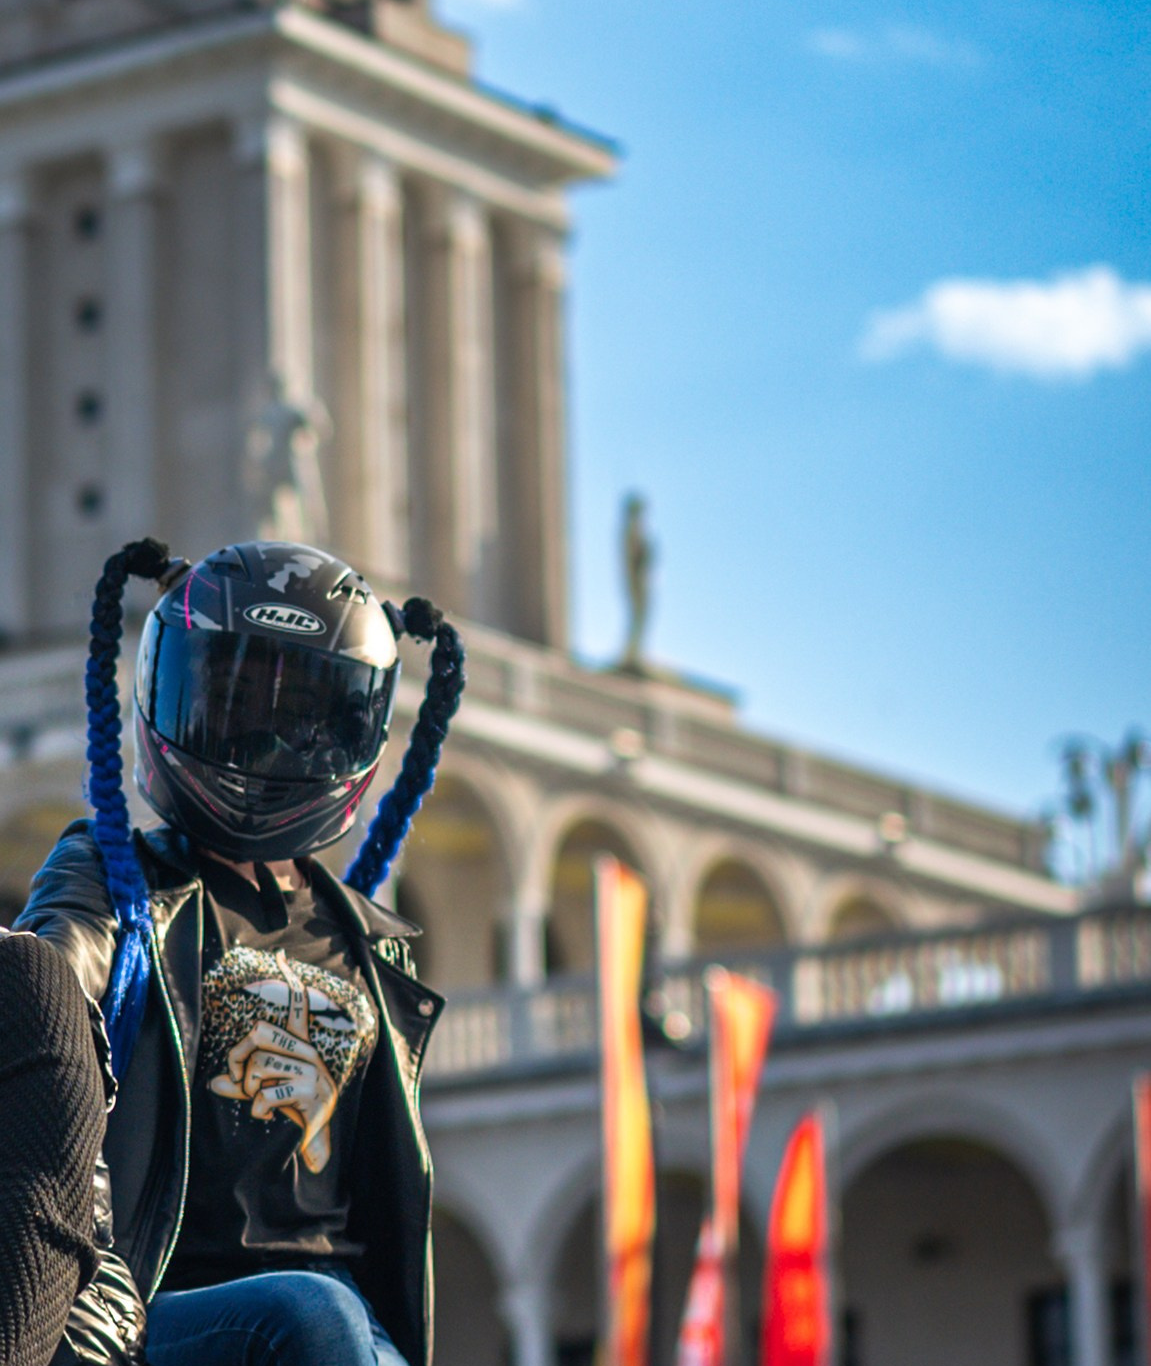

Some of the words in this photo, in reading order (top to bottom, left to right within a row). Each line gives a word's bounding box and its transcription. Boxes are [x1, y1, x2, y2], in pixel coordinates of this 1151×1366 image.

[256, 609, 315, 629] HJC
[272, 1031, 296, 1052] THE
[275, 1086, 294, 1100] UP
